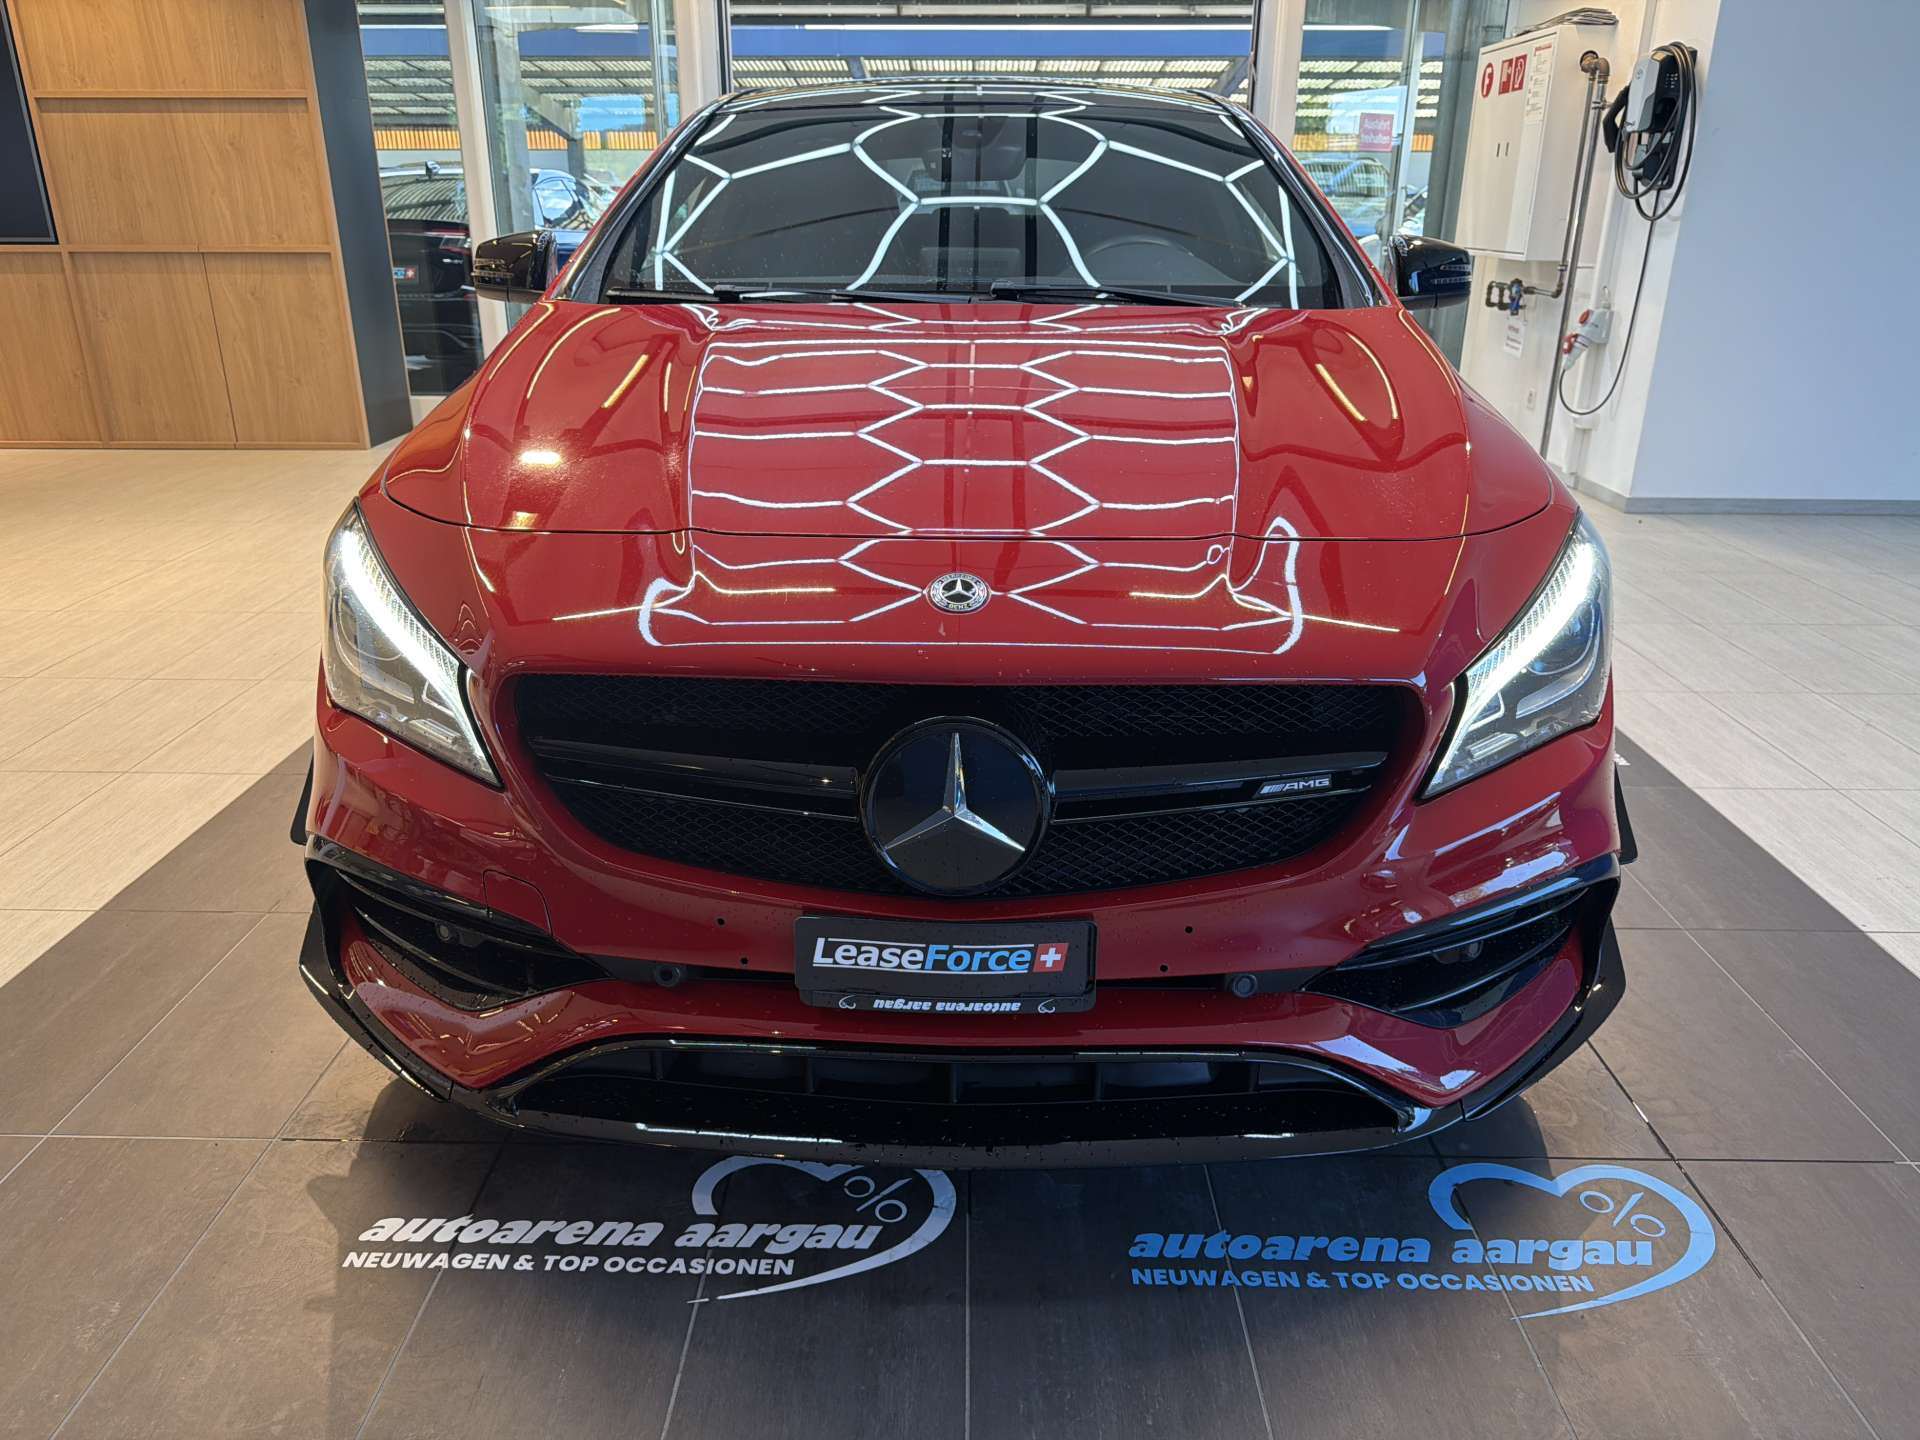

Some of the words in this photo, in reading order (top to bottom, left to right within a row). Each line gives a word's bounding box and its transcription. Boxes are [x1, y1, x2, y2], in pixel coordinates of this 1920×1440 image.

[814, 937, 1032, 971] LeaseForce
[872, 998, 932, 1010] aargau
[936, 1000, 1021, 1012] autoarena
[358, 1213, 664, 1246] autoarena
[674, 1222, 883, 1254] aargau
[1128, 1230, 1431, 1262] autoarena
[1451, 1239, 1652, 1271] aargau
[342, 1251, 510, 1269] NEUWAGEN
[513, 1253, 536, 1272] &
[542, 1254, 599, 1273] TOP
[604, 1257, 795, 1275] OCCASIONEN
[1131, 1268, 1300, 1287] NEUWAGEN
[1306, 1272, 1330, 1290] &
[1333, 1271, 1390, 1290] TOP
[1398, 1272, 1594, 1292] OCCASIONEN
